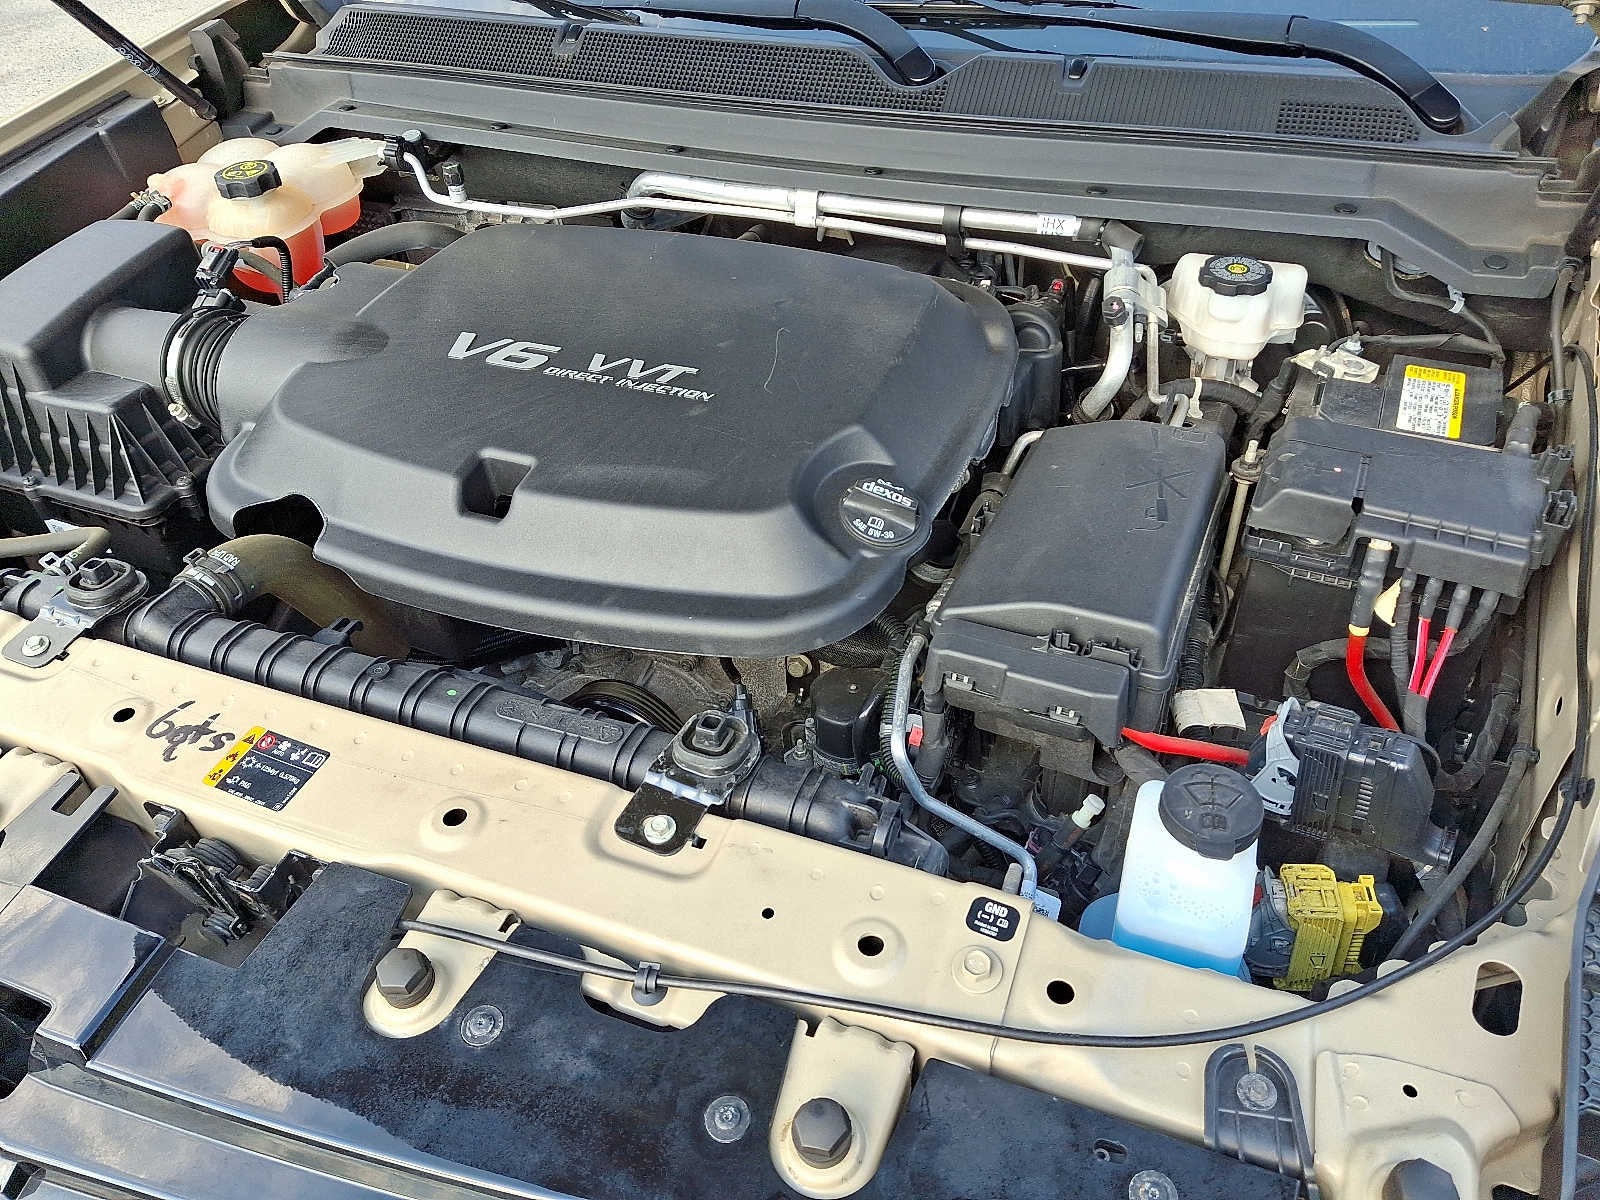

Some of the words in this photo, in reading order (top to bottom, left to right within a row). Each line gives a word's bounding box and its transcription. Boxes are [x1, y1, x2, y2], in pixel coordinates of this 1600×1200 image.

[447, 331, 562, 371] V6
[587, 352, 700, 384] VVT
[542, 366, 613, 384] DIRECT
[615, 378, 715, 402] INJECTION
[862, 482, 914, 507] dexos
[984, 901, 1008, 918] GND
